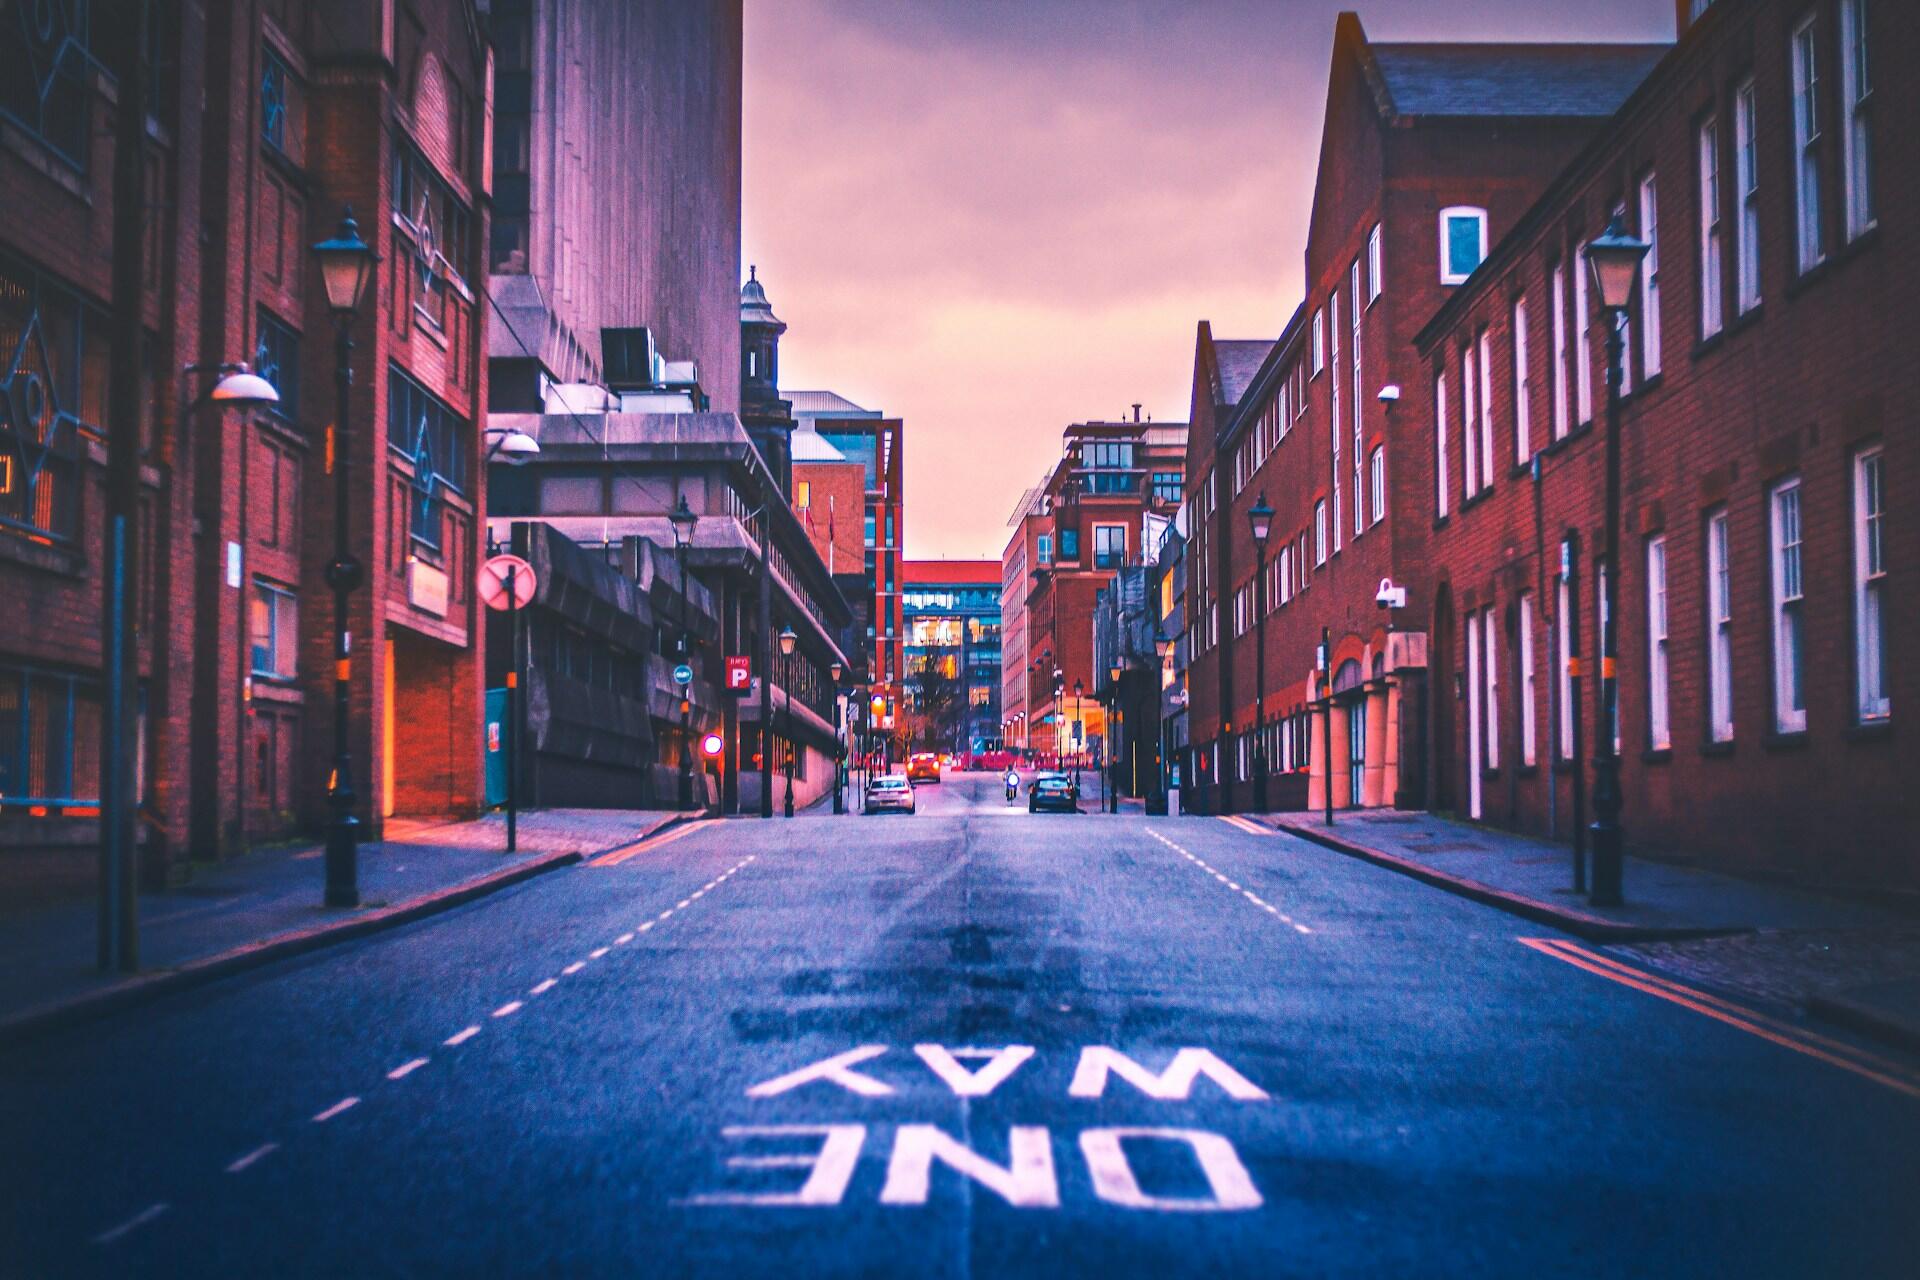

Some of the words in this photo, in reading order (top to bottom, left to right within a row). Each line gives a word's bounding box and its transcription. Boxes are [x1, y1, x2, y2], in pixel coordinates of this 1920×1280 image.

[732, 669, 748, 687] P
[746, 1043, 1269, 1099] WAY
[675, 1124, 1264, 1210] ONE
